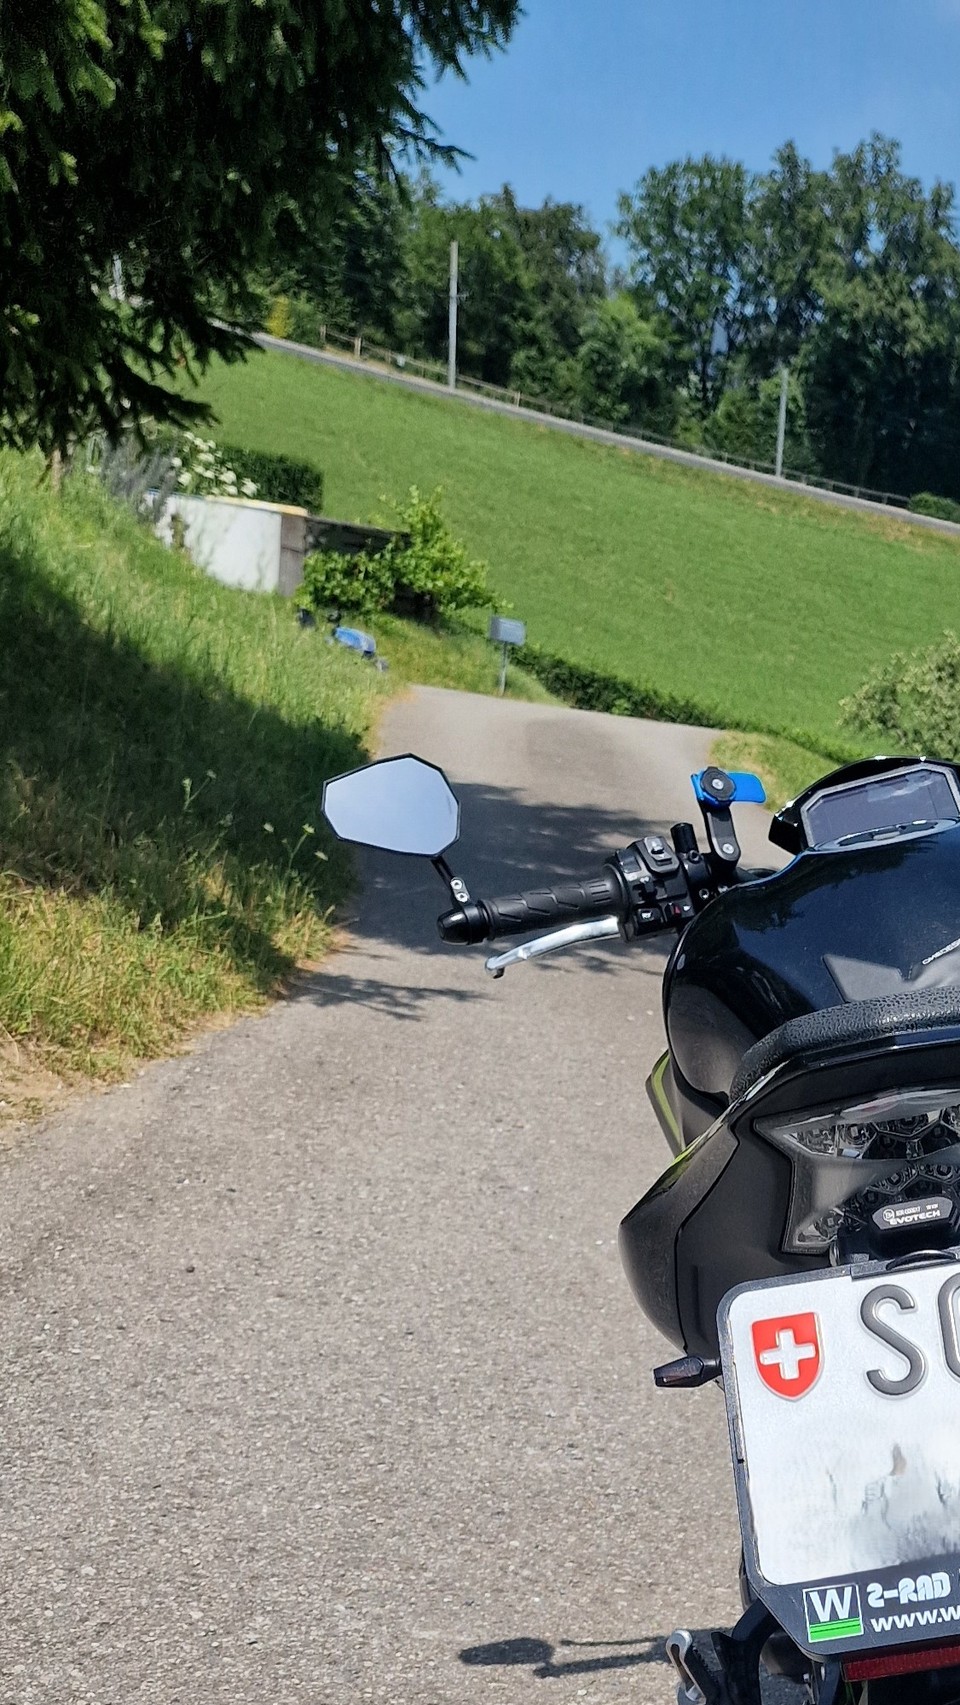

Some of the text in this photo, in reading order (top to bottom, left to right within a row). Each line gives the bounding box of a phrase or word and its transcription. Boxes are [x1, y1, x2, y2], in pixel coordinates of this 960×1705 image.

[889, 1209, 941, 1226] EVOTECH
[808, 1586, 852, 1622] W
[866, 1571, 951, 1608] 2-RAD
